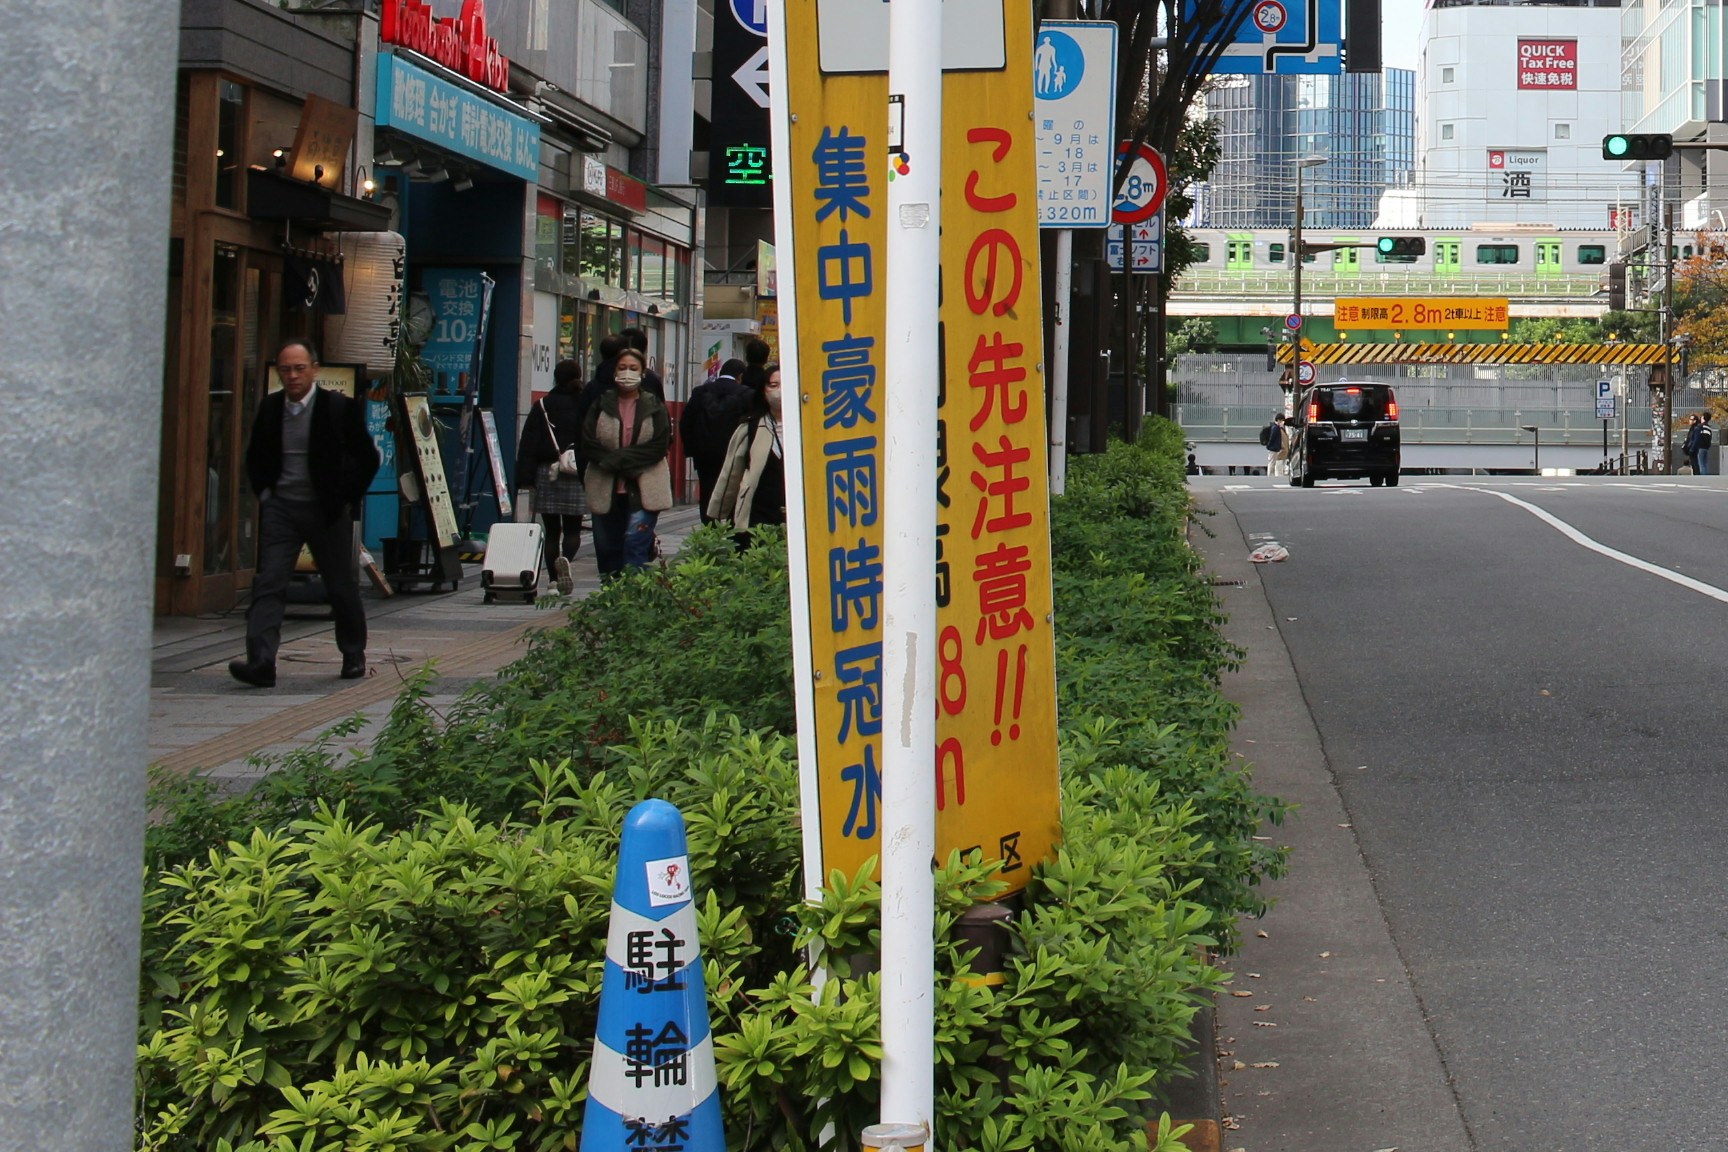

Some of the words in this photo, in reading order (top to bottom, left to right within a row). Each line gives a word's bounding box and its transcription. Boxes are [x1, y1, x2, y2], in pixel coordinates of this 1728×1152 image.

[1520, 45, 1565, 57] QUICK
[1520, 57, 1544, 69] Tax
[1545, 57, 1574, 69] Free
[1521, 72, 1574, 86] 快速免税
[429, 85, 458, 139] 合かぎ
[515, 127, 537, 171] はんこ
[725, 143, 767, 185] 空
[1509, 156, 1539, 165] Liquor
[1502, 170, 1532, 198] 酒
[438, 278, 478, 299] 電池
[442, 300, 475, 317] 交換
[1337, 305, 1360, 322] 注意
[1361, 307, 1389, 320] 制限高
[1444, 307, 1482, 320] 2t車以上
[1484, 305, 1506, 322] 注意
[1599, 381, 1610, 398] P
